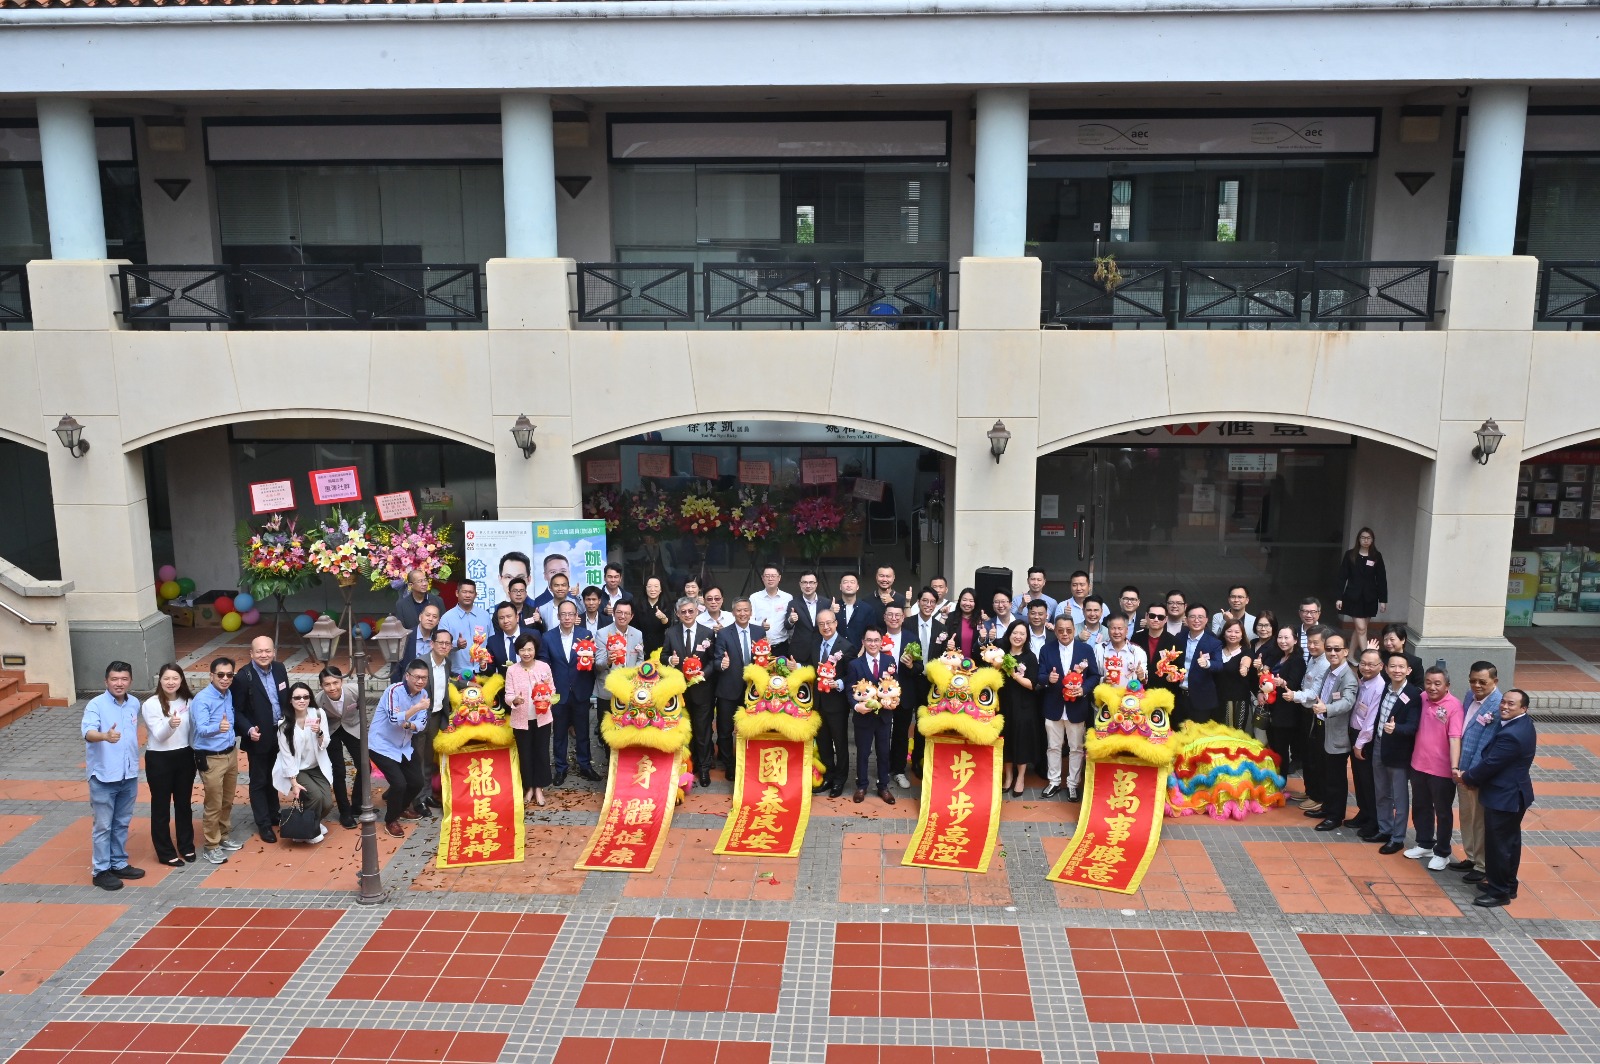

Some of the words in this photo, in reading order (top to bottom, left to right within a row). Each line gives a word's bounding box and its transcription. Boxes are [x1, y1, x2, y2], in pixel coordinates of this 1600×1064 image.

[1131, 128, 1149, 138] aec
[1305, 127, 1323, 137] aec
[585, 550, 602, 585] 姚柏
[463, 757, 503, 858] 龍馬精神
[602, 754, 657, 865] 身體健康
[741, 747, 789, 850] 國泰民安
[929, 750, 976, 864] 步步高陞
[1080, 769, 1140, 882] 萬事勝意
